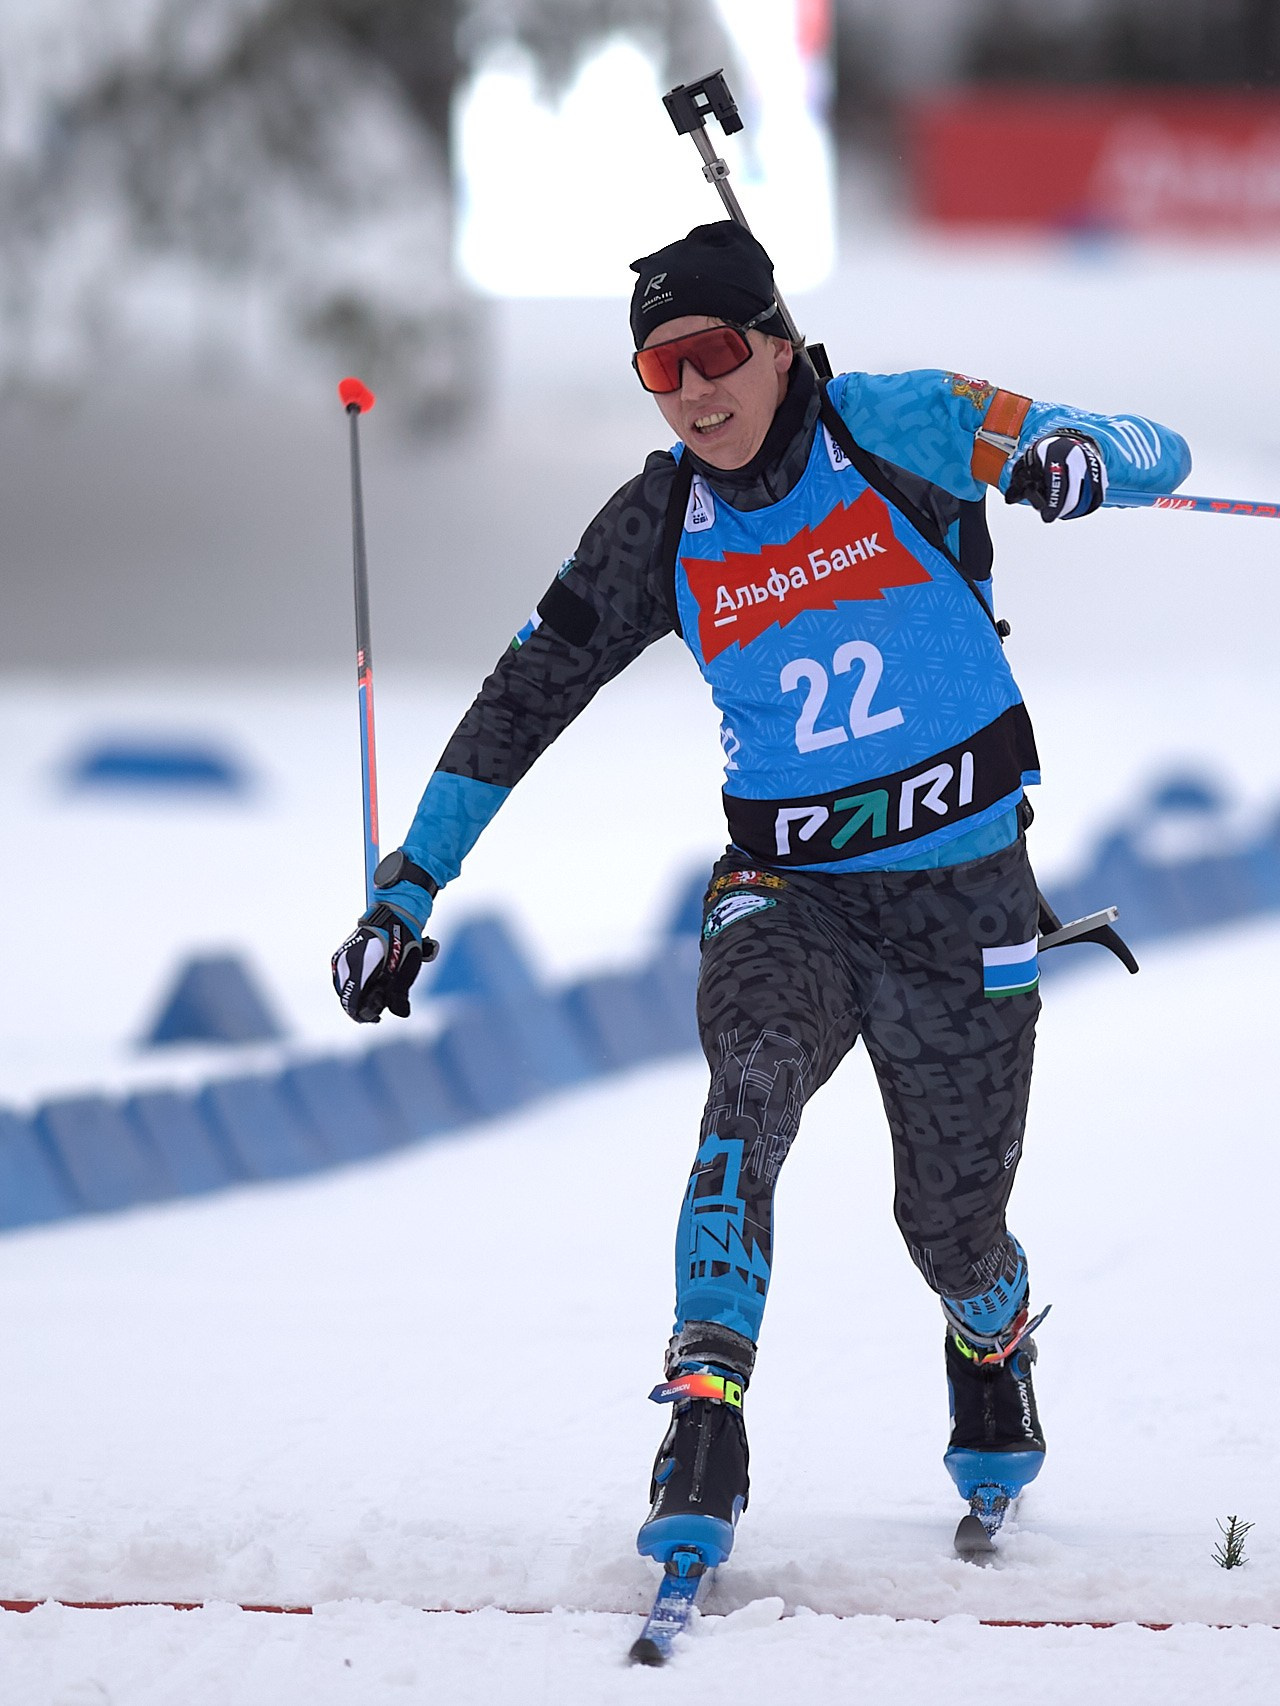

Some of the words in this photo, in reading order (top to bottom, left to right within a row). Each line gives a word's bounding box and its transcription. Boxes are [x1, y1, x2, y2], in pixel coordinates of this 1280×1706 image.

[714, 566, 808, 614] Альфа
[807, 532, 887, 581] Банк
[779, 640, 905, 754] 22
[775, 751, 974, 855] PARI
[660, 1383, 691, 1397] SALOMON
